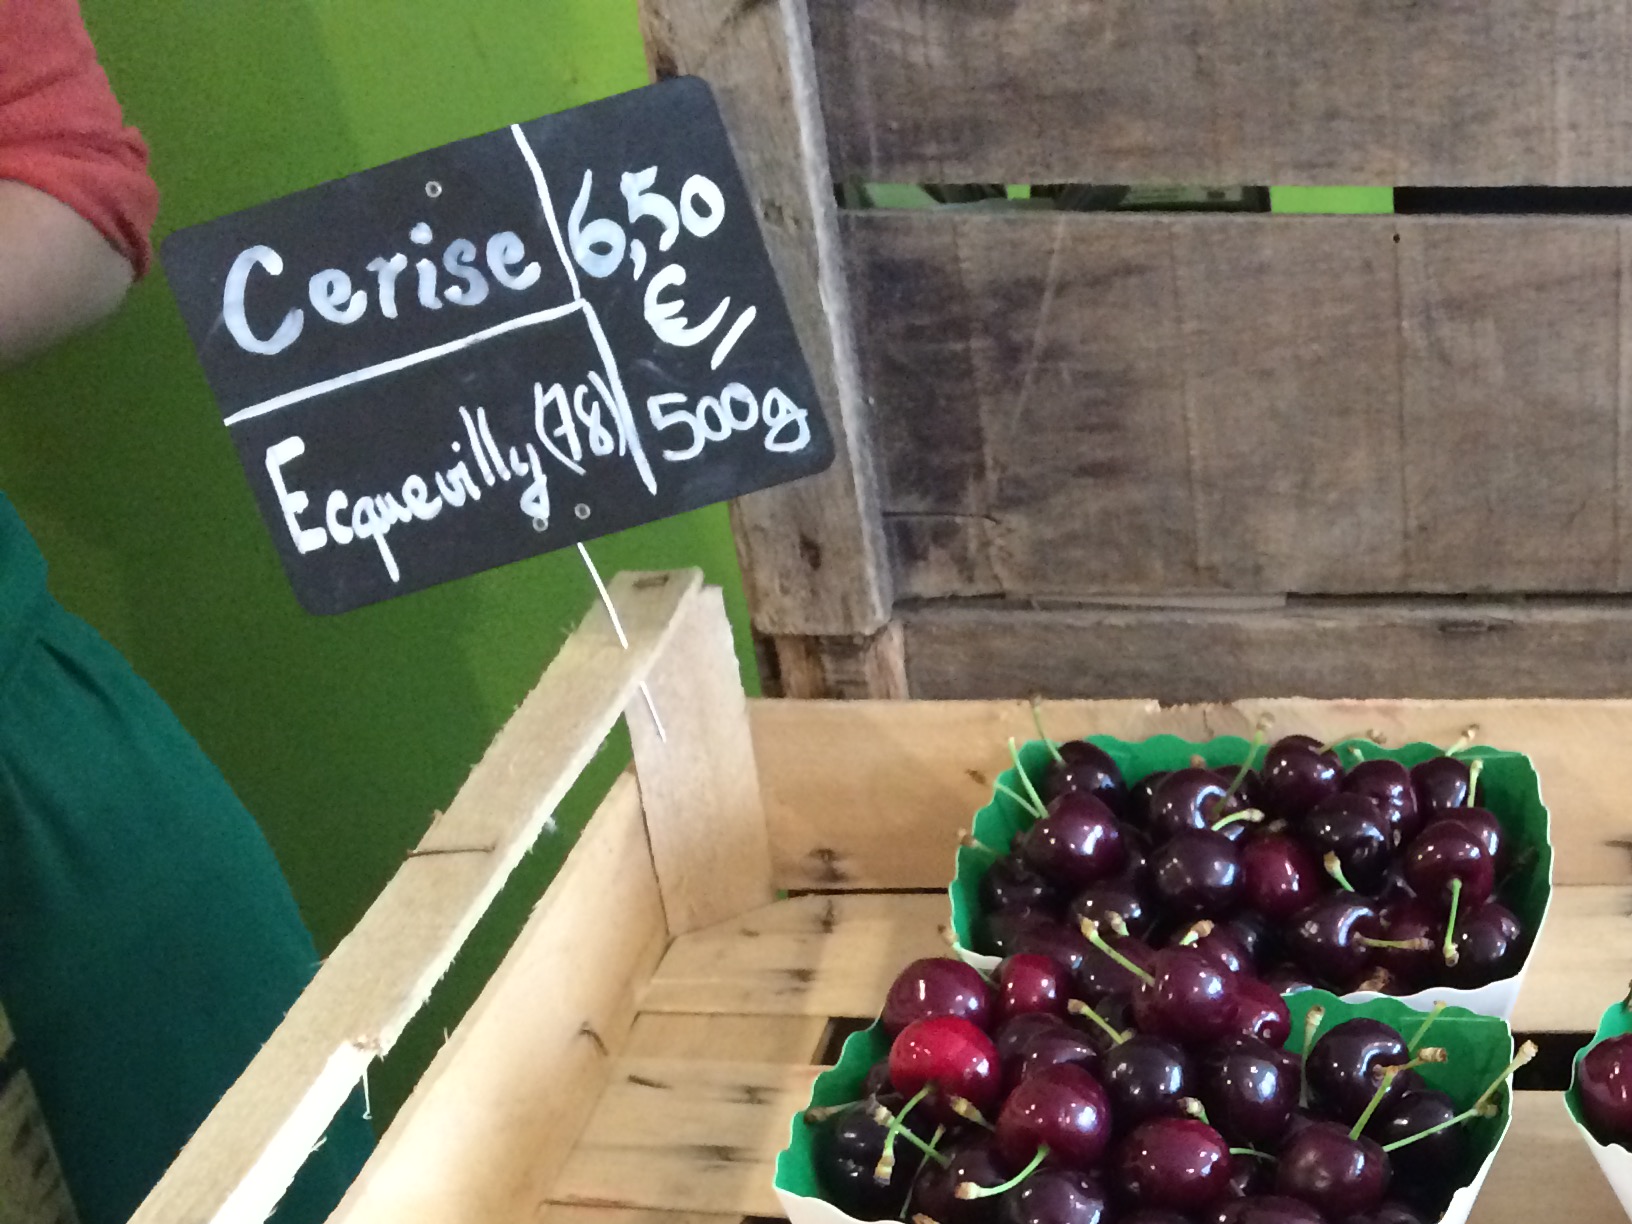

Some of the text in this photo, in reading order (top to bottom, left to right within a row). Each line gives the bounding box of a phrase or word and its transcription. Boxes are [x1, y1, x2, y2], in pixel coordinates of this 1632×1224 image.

[567, 165, 726, 279] 6,50
[223, 223, 541, 355] Cerise
[646, 382, 812, 462] 500g
[264, 405, 551, 583] Ecquevilly
